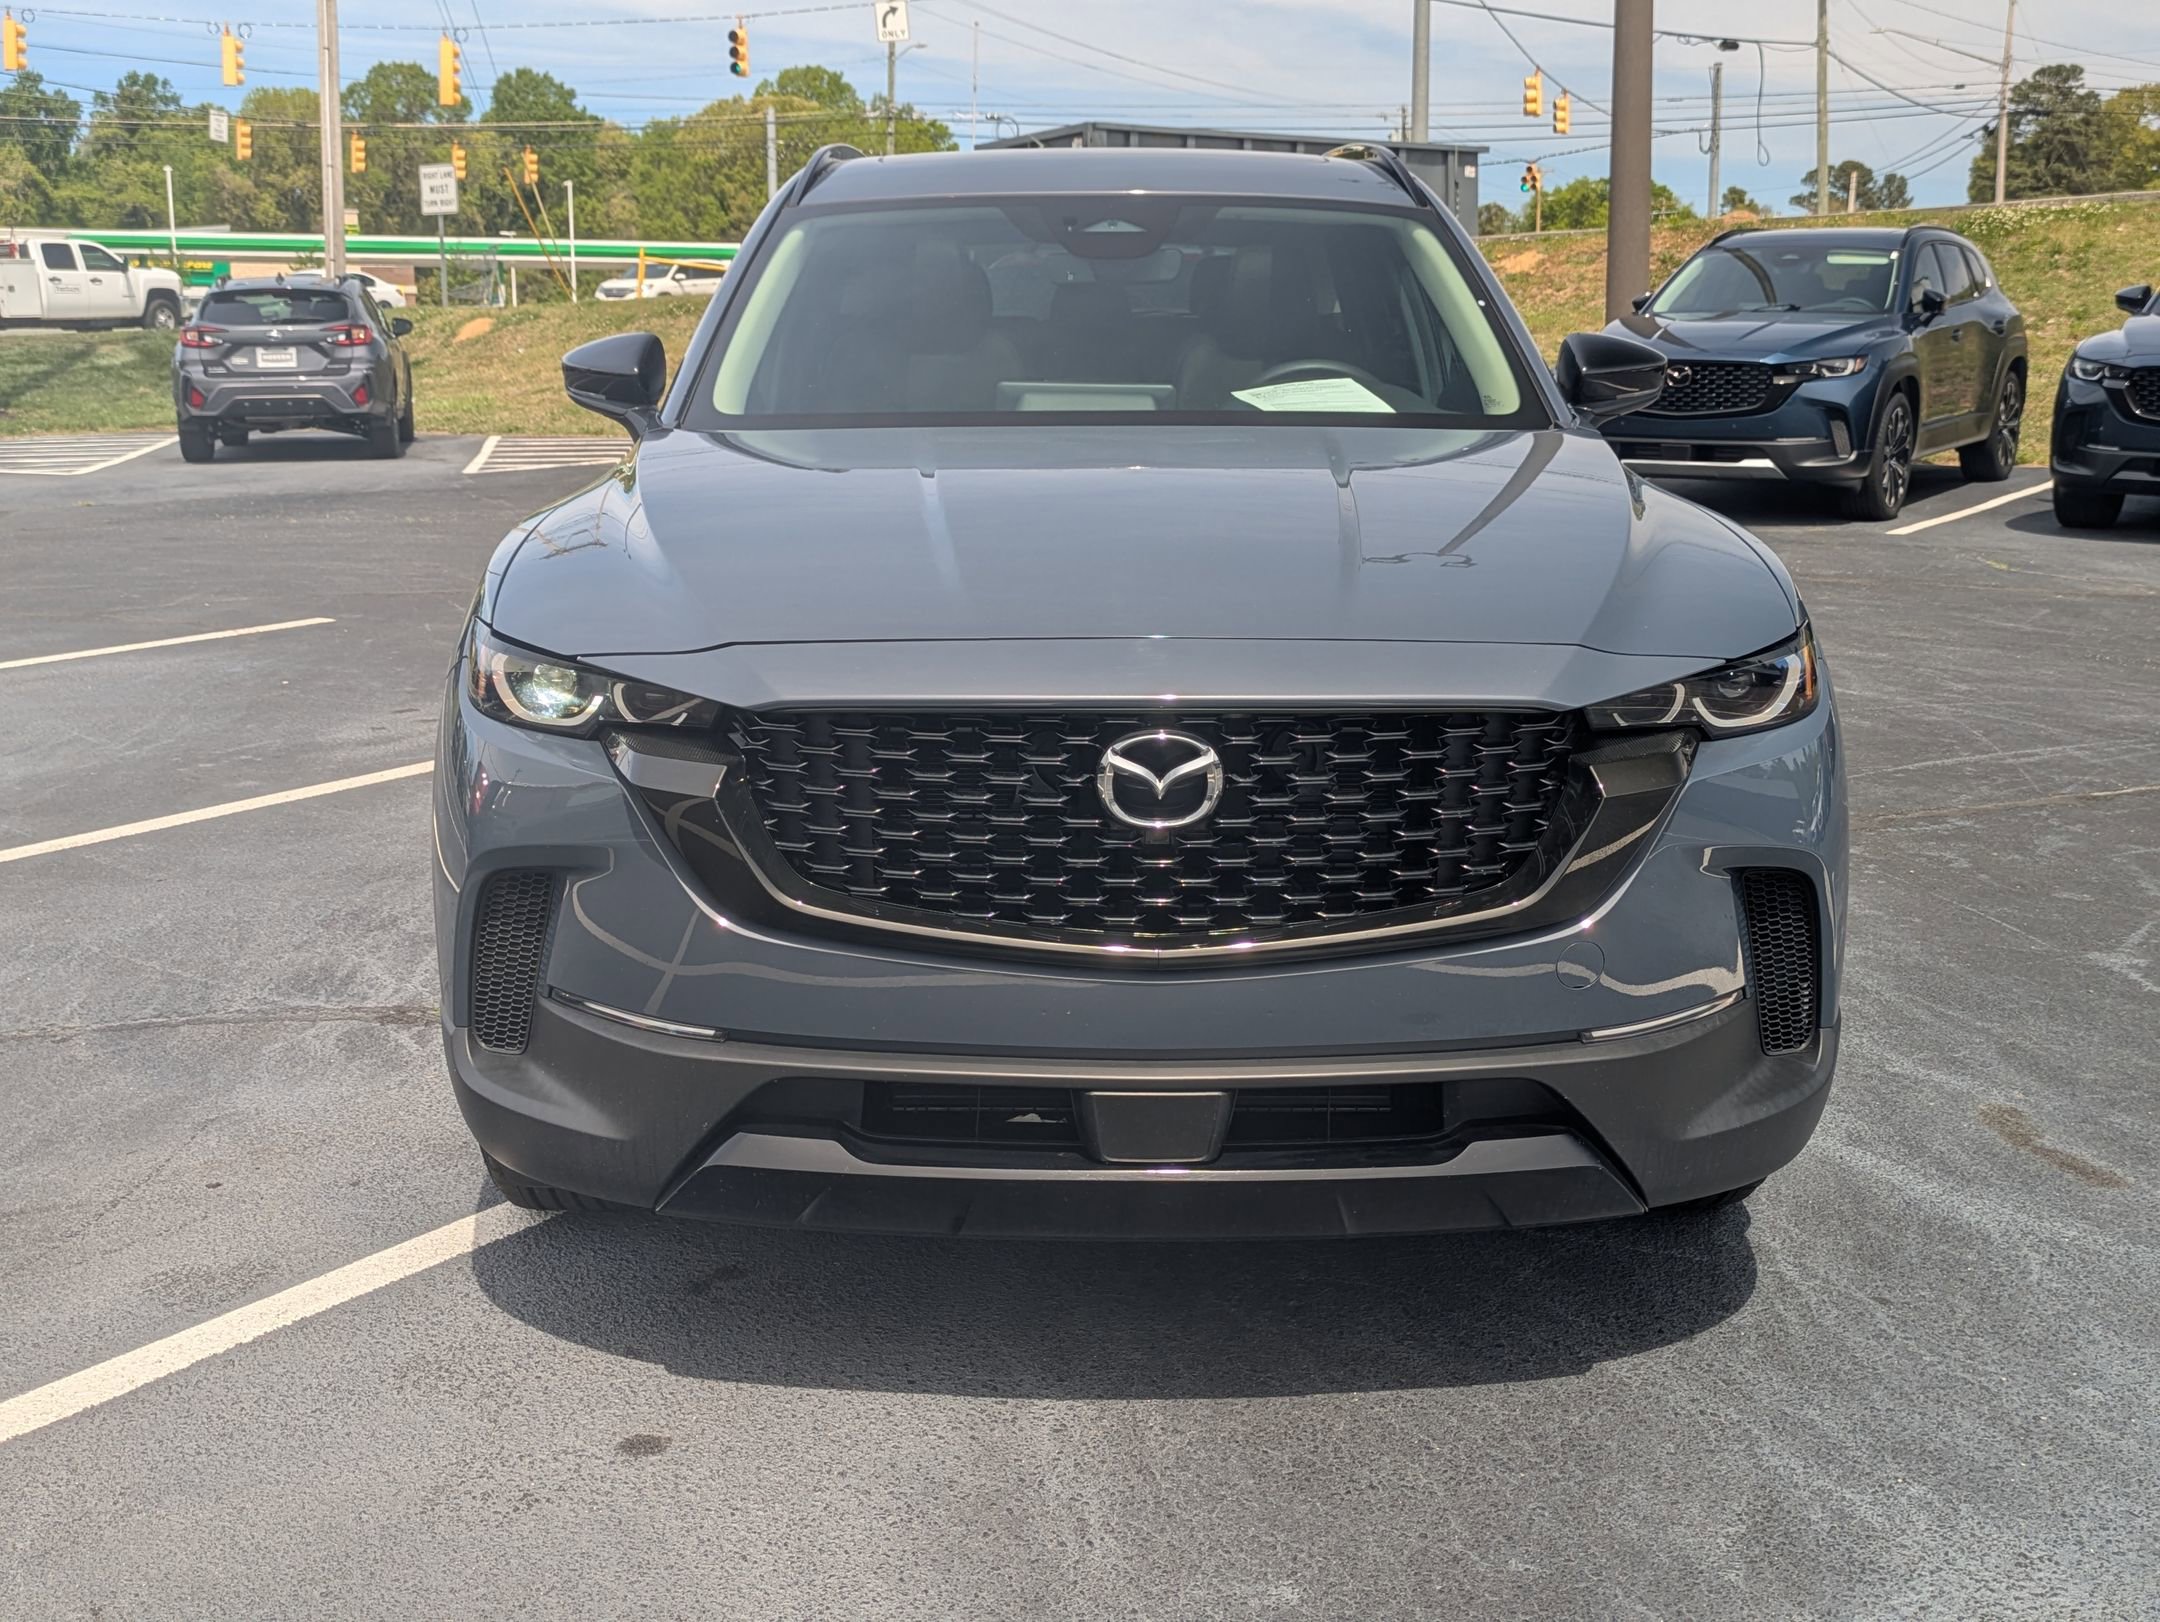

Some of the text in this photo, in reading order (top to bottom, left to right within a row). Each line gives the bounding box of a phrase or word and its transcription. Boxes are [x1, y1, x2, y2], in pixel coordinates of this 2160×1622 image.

[881, 30, 906, 39] ONLY
[423, 171, 454, 180] RIGHT LANE
[429, 184, 449, 195] MUST
[424, 198, 455, 207] TURN RIGHT
